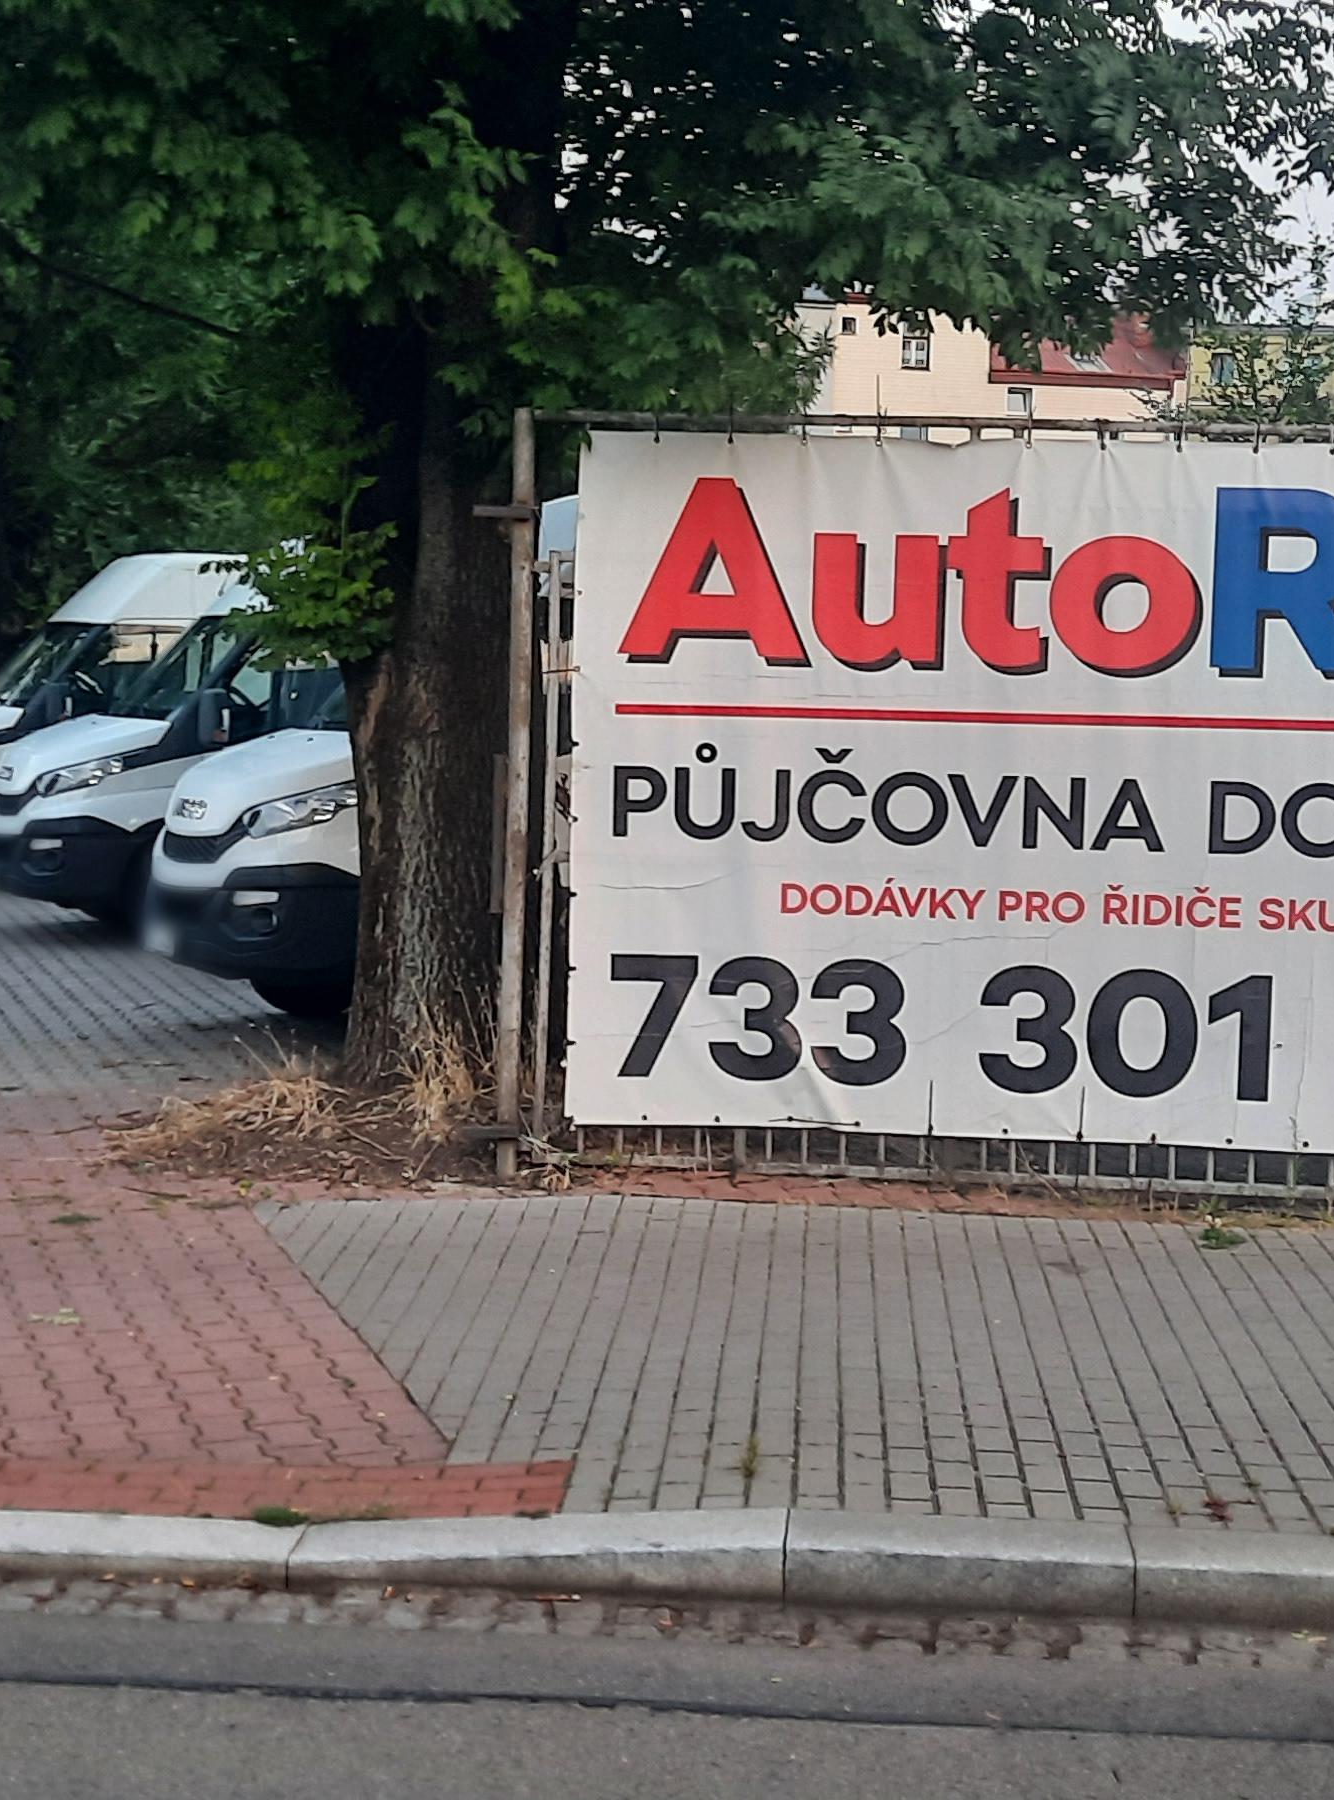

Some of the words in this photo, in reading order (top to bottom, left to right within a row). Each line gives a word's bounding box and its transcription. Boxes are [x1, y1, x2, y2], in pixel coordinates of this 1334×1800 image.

[611, 742, 1164, 852] PŮJČOVNA
[779, 878, 985, 920] DODÁVKY
[997, 889, 1086, 924] PRO
[1102, 884, 1242, 929] ŘIDIČE
[610, 953, 908, 1086] 733
[978, 966, 1274, 1102] 301
